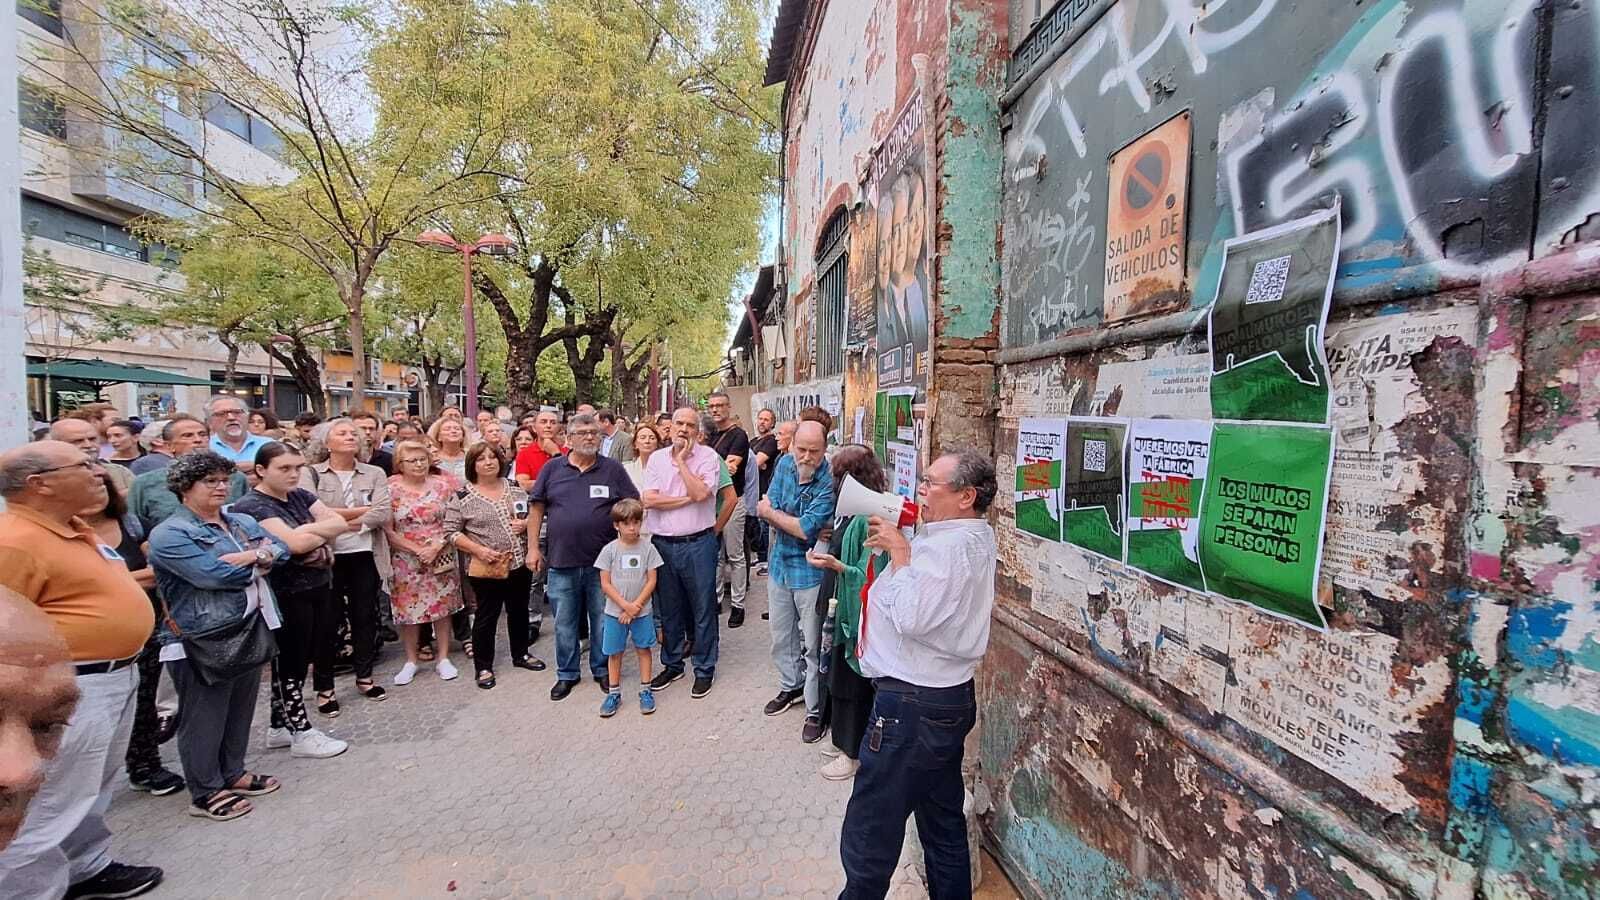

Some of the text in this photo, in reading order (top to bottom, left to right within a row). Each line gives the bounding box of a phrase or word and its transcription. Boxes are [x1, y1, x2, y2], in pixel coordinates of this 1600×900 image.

[1109, 213, 1179, 259] SALIDA DE
[1107, 244, 1178, 285] VEHICULOS
[1134, 437, 1208, 458] QUEREMOS VER
[1142, 454, 1152, 471] LA
[1219, 478, 1311, 511] LOS MUROS
[1223, 503, 1297, 535] SEPARAN
[1214, 525, 1300, 563] PERSONAS
